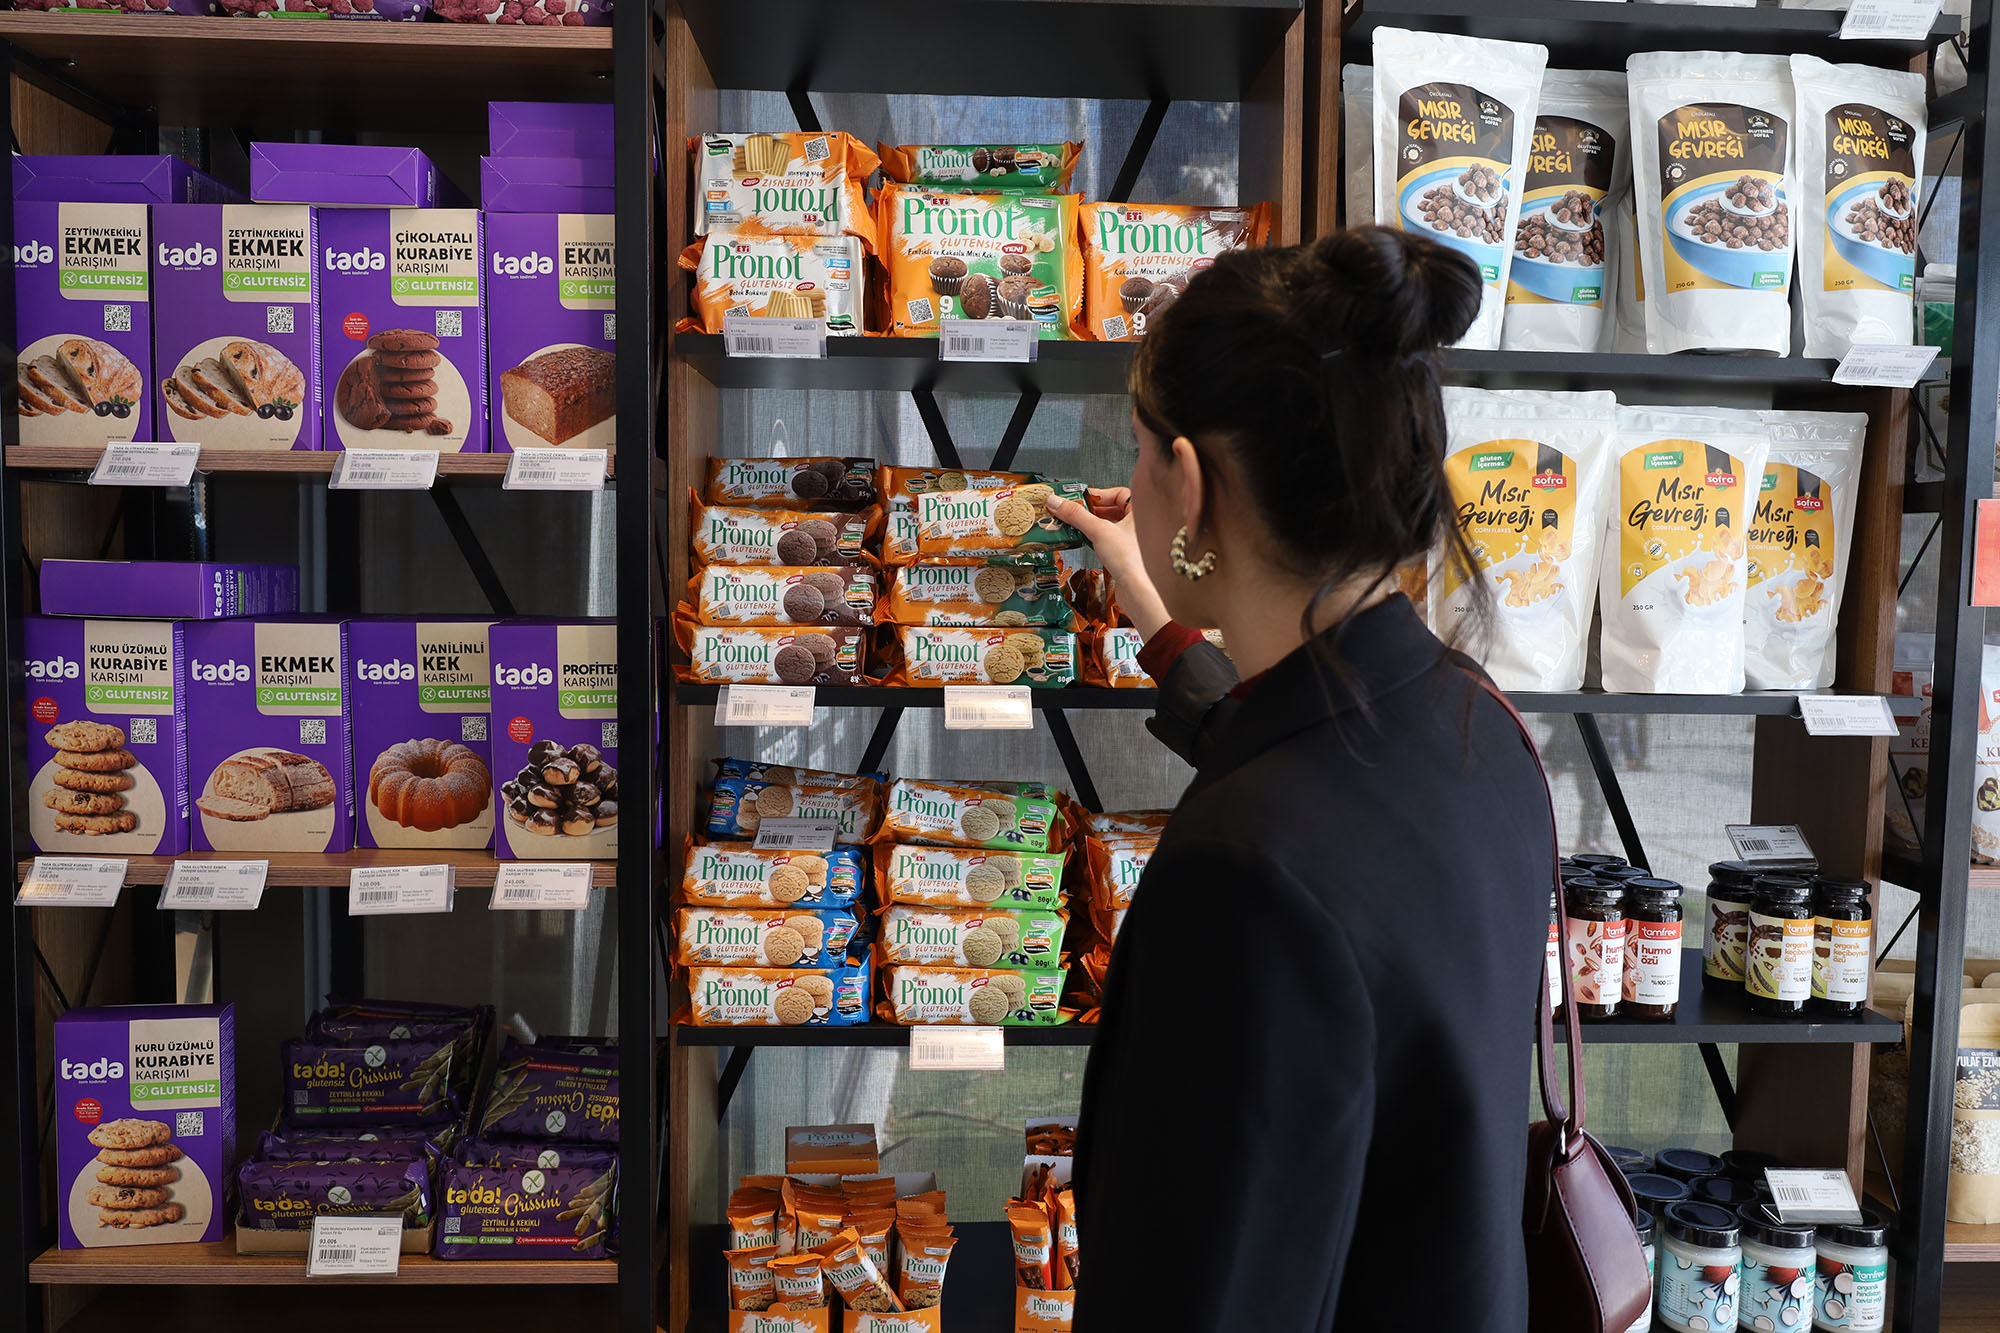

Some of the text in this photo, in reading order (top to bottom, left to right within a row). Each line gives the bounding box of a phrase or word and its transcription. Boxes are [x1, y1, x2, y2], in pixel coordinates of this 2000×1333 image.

[1418, 99, 1462, 119] MISIR
[1677, 120, 1727, 139] MISIR
[1837, 117, 1874, 136] MISIR
[923, 150, 973, 168] Pronot
[752, 187, 840, 222] Pronot
[903, 198, 1017, 240] Pronot
[65, 226, 141, 237] ZEYTİN/KEKİKLİ
[228, 228, 304, 238] ZEYTİN/KEKİKLİ
[396, 231, 472, 245] ÇİKOLATALI
[1098, 211, 1208, 254] Pronot
[65, 238, 141, 255] EKMEK
[159, 242, 217, 266] tada
[229, 239, 304, 256] EKMEK
[396, 246, 472, 260] KURABİYE
[65, 257, 117, 269] KARIŞIMI
[229, 259, 280, 271] KARIŞIMI
[325, 247, 385, 270] tada
[493, 251, 553, 275] tada
[712, 245, 804, 280] Pronot
[397, 263, 448, 275] KARIŞIMI
[79, 274, 143, 285] GLUTENSİZ
[243, 276, 306, 287] GLUTENSİZ
[411, 280, 474, 291] GLUTENSİZ
[939, 296, 954, 313] 9
[940, 312, 959, 320] Adet
[1133, 313, 1146, 330] 9
[728, 465, 788, 484] Pronot
[1535, 476, 1563, 485] sofra
[1480, 479, 1530, 506] Mısır
[1656, 477, 1704, 504] Mısır
[925, 498, 990, 523] Pronot
[1457, 502, 1535, 533] Gevreği
[1628, 500, 1709, 531] Gevreği
[1753, 500, 1793, 524] Mısır
[711, 519, 774, 547] Pronot
[1747, 525, 1798, 550] evreği
[214, 572, 222, 616] tada
[714, 576, 780, 602] Pronot
[858, 614, 871, 623] 85g
[90, 644, 167, 654] KURU ÜZÜMLÜ
[421, 642, 484, 654] VANİLİNLİ
[704, 637, 771, 664] Pronot
[915, 635, 980, 662] Pronot
[90, 657, 168, 670] KURABİYE
[191, 659, 250, 681] tada
[261, 656, 335, 672] EKMEK
[357, 659, 415, 680] tada
[423, 656, 460, 671] KEK
[91, 672, 143, 684] KARIŞIMI
[262, 675, 312, 686] KARIŞIMI
[424, 673, 473, 684] KARIŞIMI
[495, 663, 552, 685] tada
[564, 677, 613, 688] KARIŞIMI
[106, 688, 169, 700] GLUTENSİZ
[276, 691, 337, 701] GLUTENSİZ
[896, 789, 958, 820] Pronot
[702, 856, 765, 881] Pronot
[899, 855, 962, 880] Pronot
[696, 920, 761, 945] Pronot
[895, 919, 958, 946] Pronot
[1641, 926, 1677, 938] tamfree
[1641, 945, 1671, 954] hurma
[1641, 955, 1658, 965] özü
[706, 981, 770, 1006] Pronot
[901, 980, 965, 1005] Pronot
[135, 1040, 213, 1052] KURU ÜZÜMLÜ
[61, 1057, 124, 1080] tada
[135, 1052, 214, 1068] KURABİYE
[136, 1069, 189, 1081] KARIŞIMI
[307, 1078, 345, 1088] glutensiz
[350, 1064, 402, 1088] Grissini
[151, 1083, 215, 1095] GLUTENSİZ
[460, 1205, 500, 1216] glutensiz
[504, 1190, 560, 1218] Grissini
[272, 1209, 313, 1218] glutensiz
[829, 1263, 867, 1285] Pronot
[906, 1258, 945, 1273] Pronot
[1033, 1299, 1063, 1311] Pronot
[755, 1319, 795, 1333] Pronot
[870, 1319, 909, 1333] Pronot
